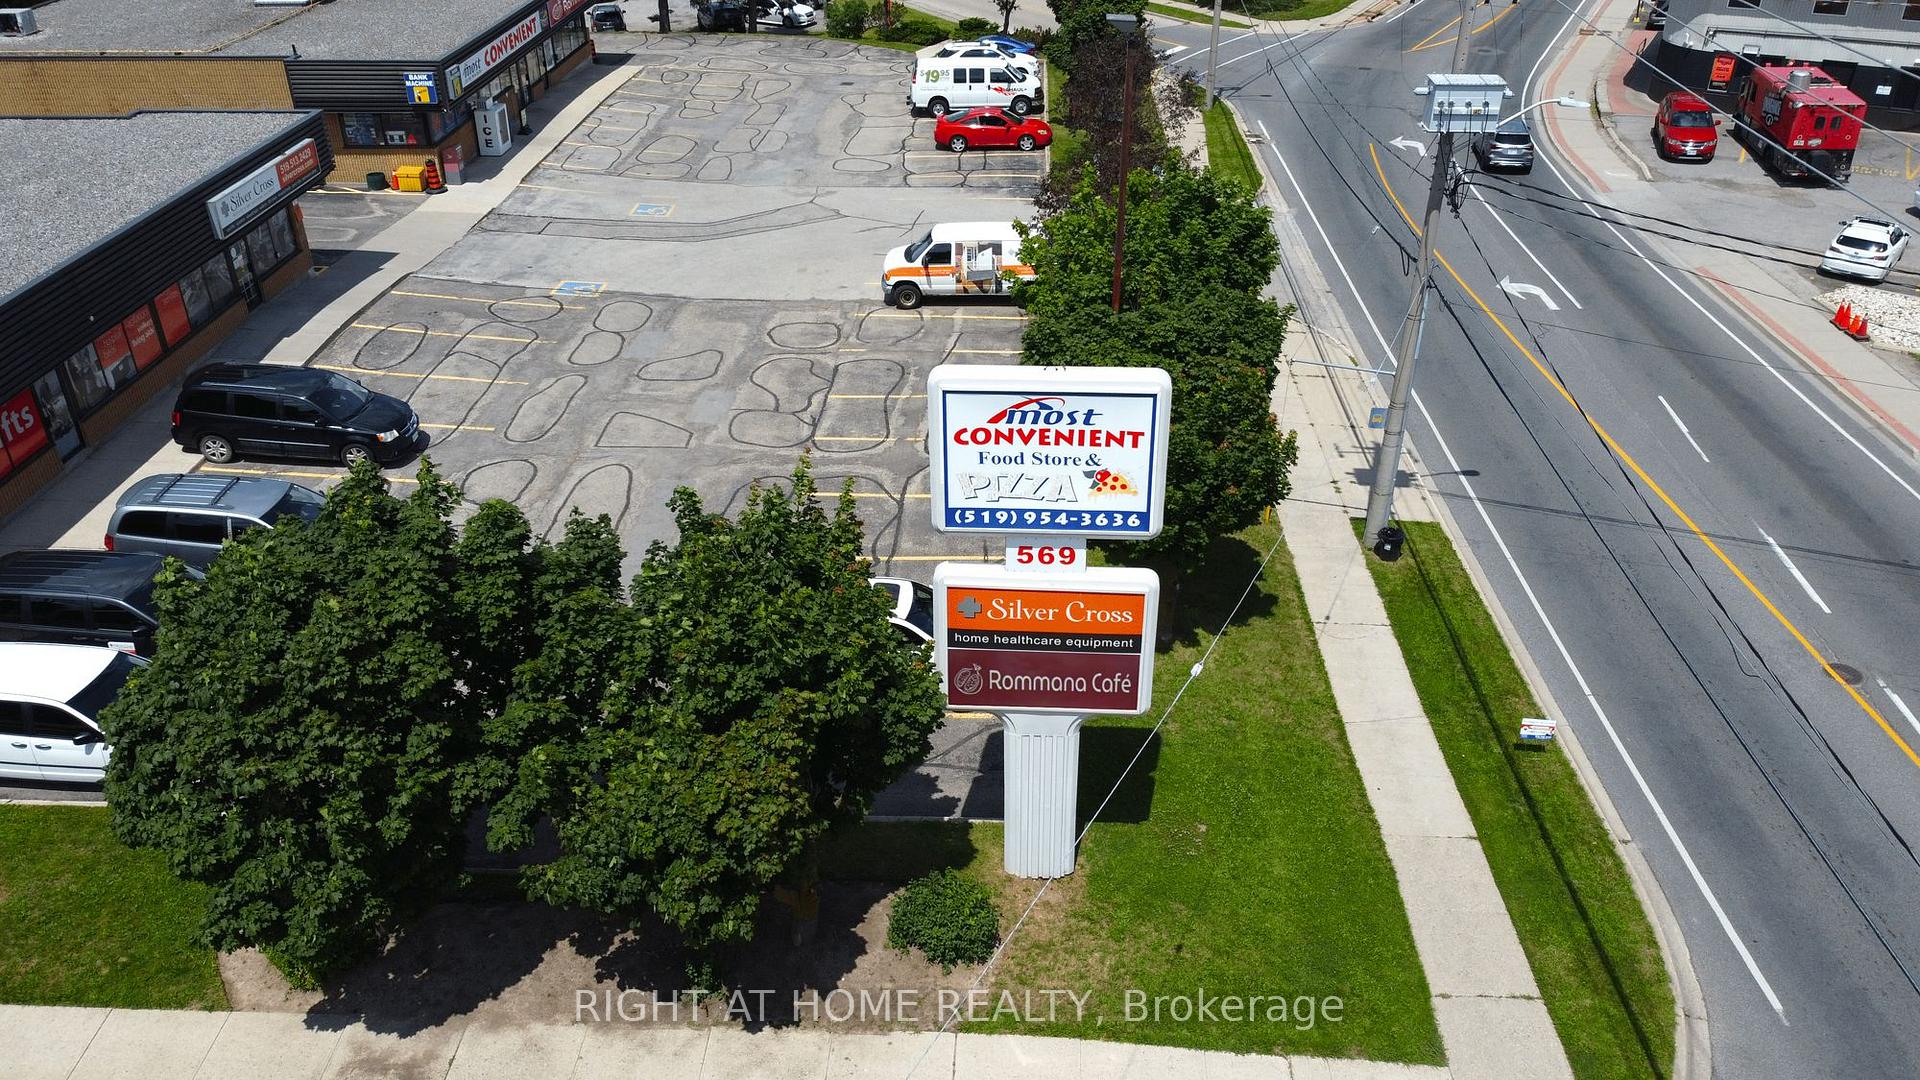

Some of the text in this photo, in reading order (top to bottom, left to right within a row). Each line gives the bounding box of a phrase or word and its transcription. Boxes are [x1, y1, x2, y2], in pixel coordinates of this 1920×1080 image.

[484, 16, 537, 67] CONVENIENT
[483, 114, 495, 149] ICE
[229, 191, 252, 211] Silver
[252, 177, 275, 196] Cross
[0, 405, 34, 443] fts
[1005, 408, 1104, 426] most
[953, 427, 1145, 449] CONVENIENT
[978, 451, 1103, 467] Food Store &
[956, 471, 1079, 503] PIZZA
[954, 510, 1141, 528] (519) 954-3636
[1016, 545, 1077, 566] 569
[986, 598, 1134, 624] Silver Cross
[954, 632, 1134, 649] home healthcare equipment
[988, 669, 1132, 694] Rommana Café
